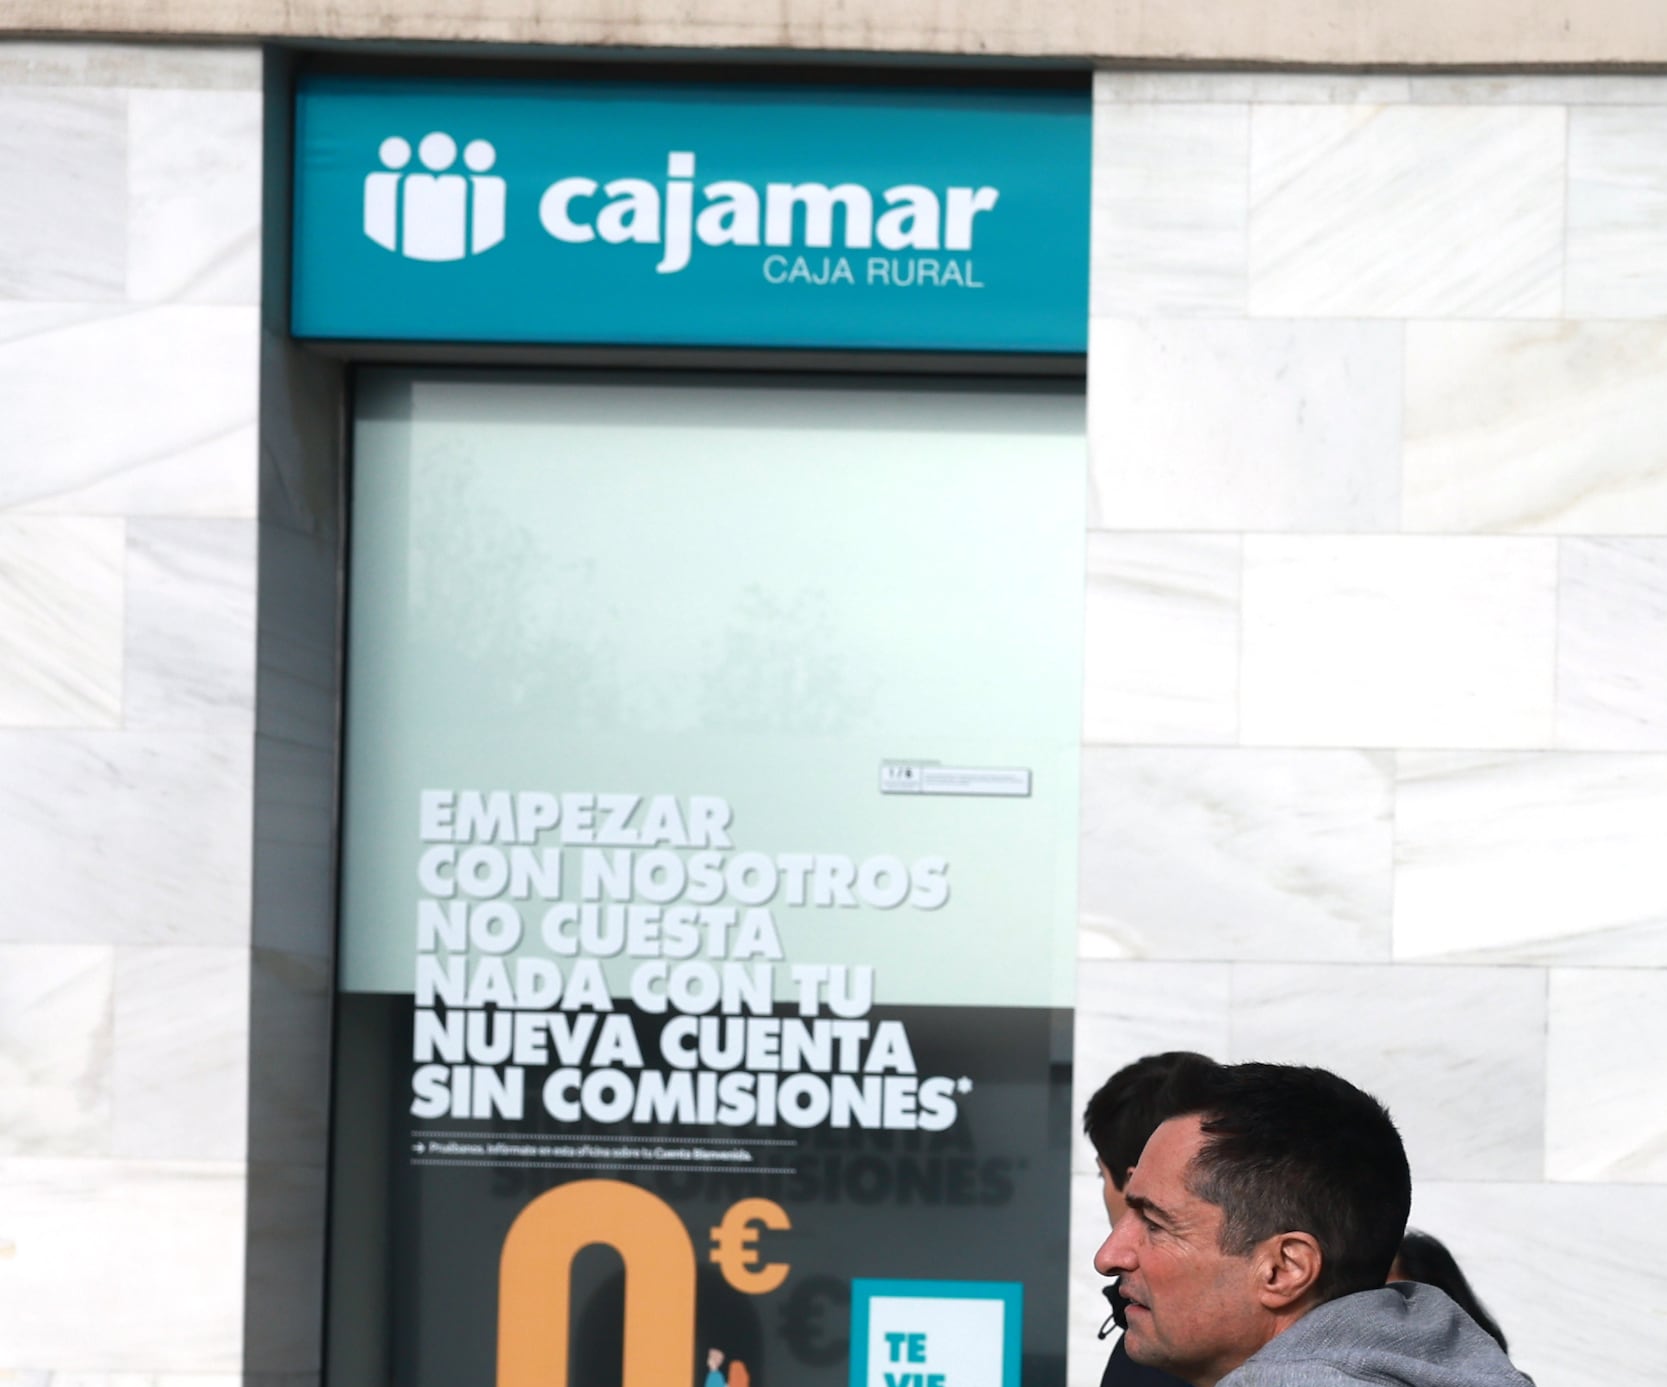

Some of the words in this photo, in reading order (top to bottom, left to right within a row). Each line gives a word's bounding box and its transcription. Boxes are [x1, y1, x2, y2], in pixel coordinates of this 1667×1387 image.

[540, 152, 998, 274] cajamar
[763, 254, 855, 286] CAJA
[866, 256, 985, 288] RURAL
[420, 790, 732, 846] EMPEZAR
[418, 846, 561, 899] CON
[582, 851, 949, 908] NOSOTROS
[417, 900, 522, 954] NO
[541, 904, 783, 959] CUESTA
[415, 955, 612, 1011] NADA
[630, 961, 772, 1014] CON
[791, 965, 873, 1018] TU
[414, 1011, 643, 1068] NUEVA
[660, 1016, 916, 1073] CUENTA
[410, 1064, 524, 1119] SIN
[885, 1332, 927, 1363] TE
